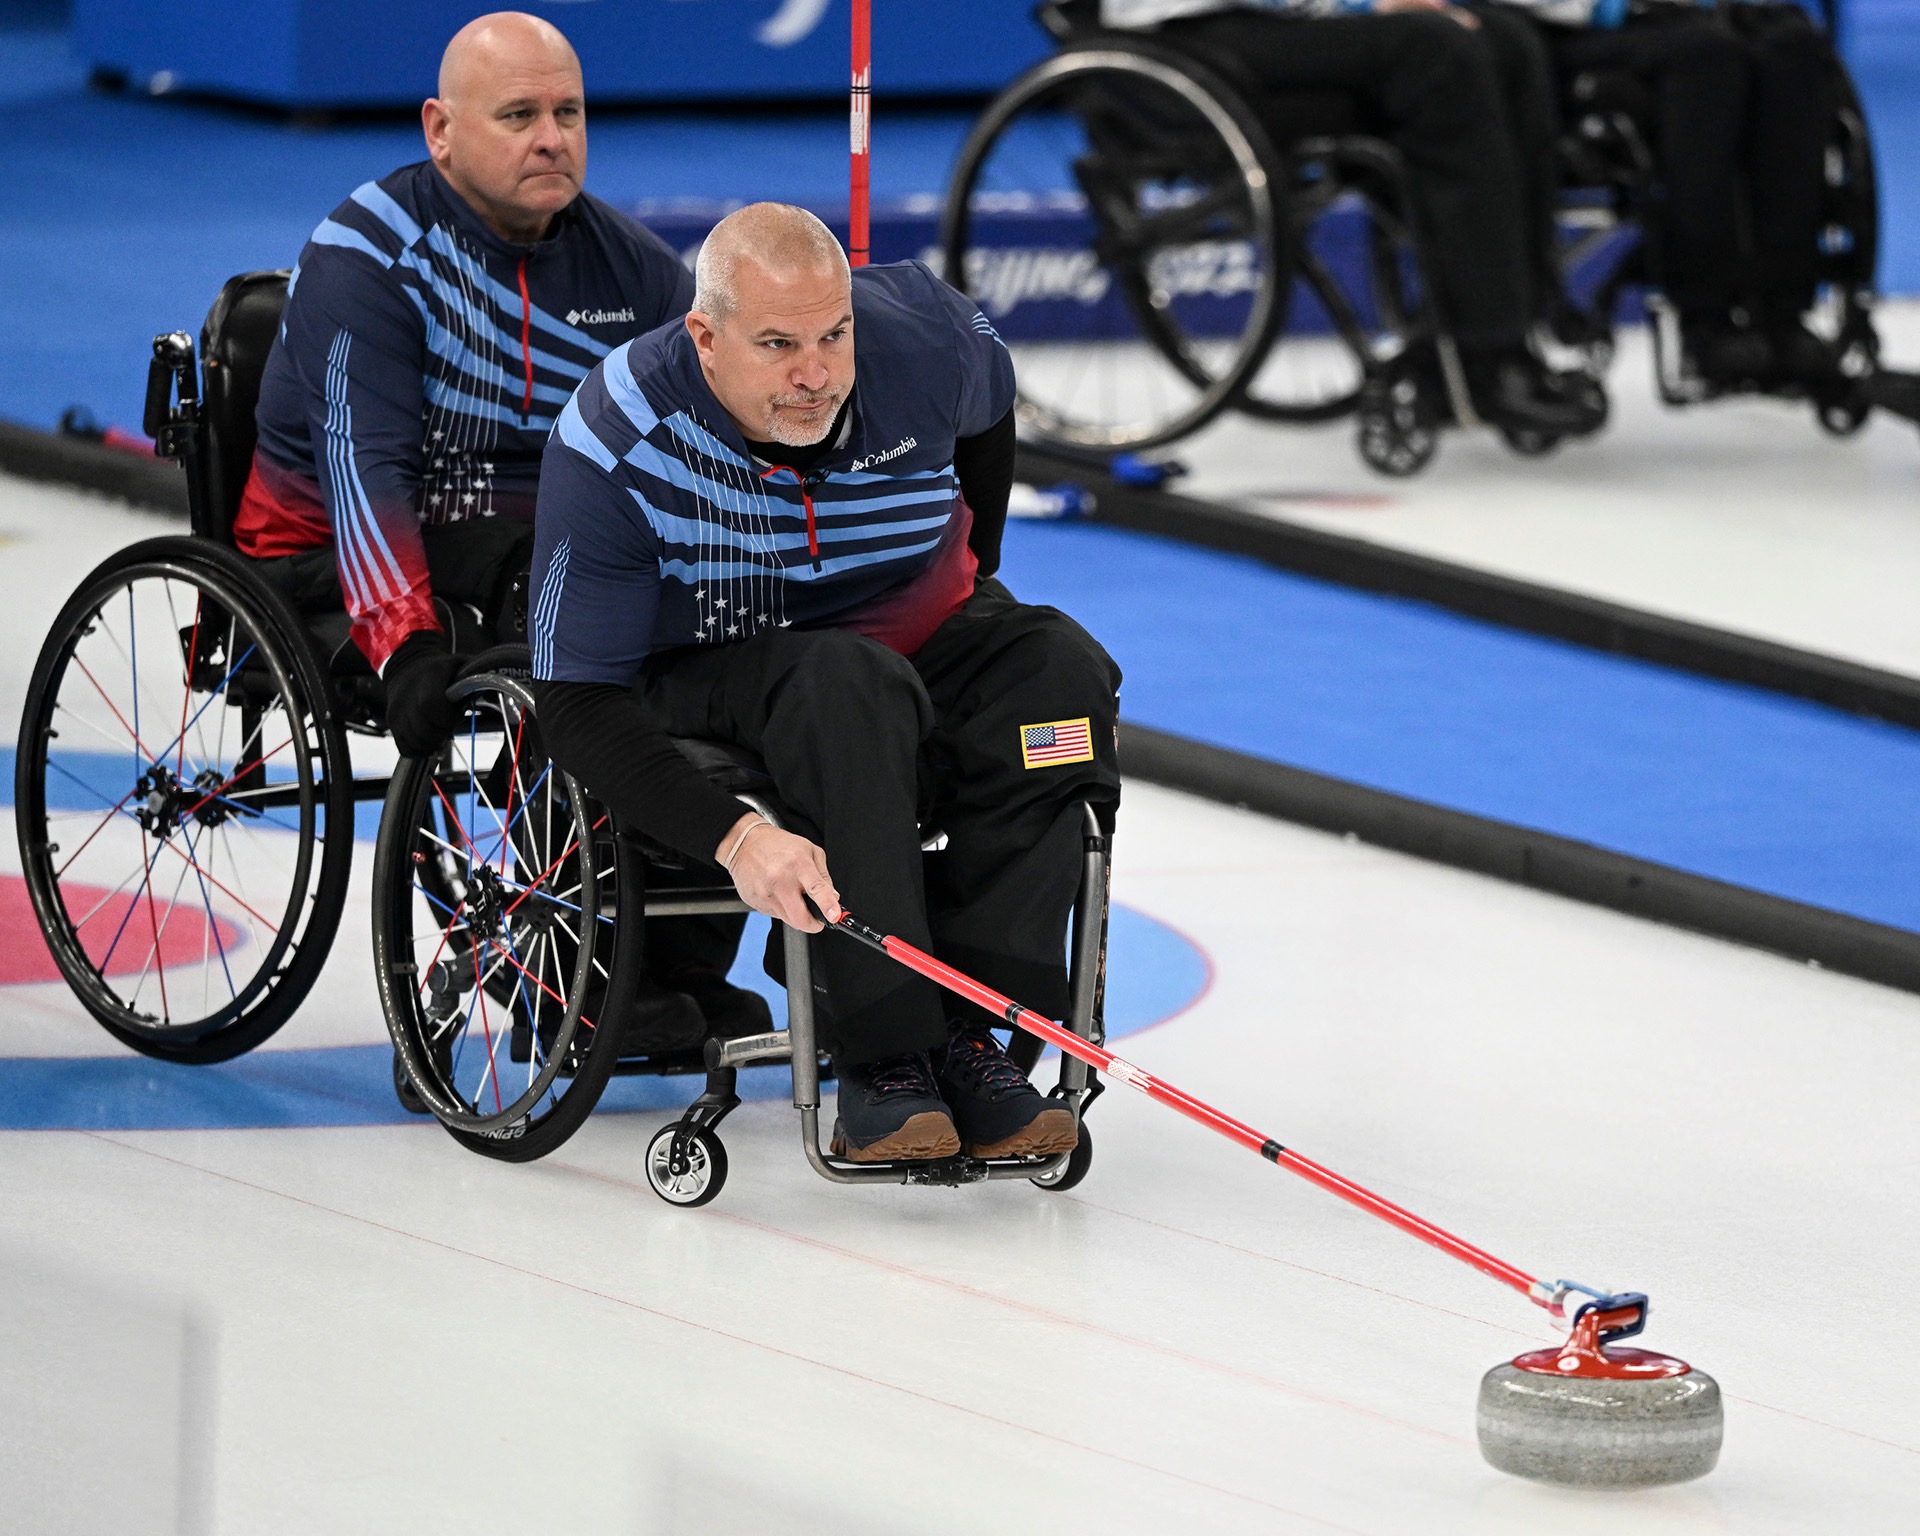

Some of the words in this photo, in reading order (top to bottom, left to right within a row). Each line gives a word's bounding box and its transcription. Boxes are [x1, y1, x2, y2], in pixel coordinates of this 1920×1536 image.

[922, 246, 1111, 318] EIJING
[581, 307, 636, 325] Columbi
[864, 436, 918, 468] Columbia
